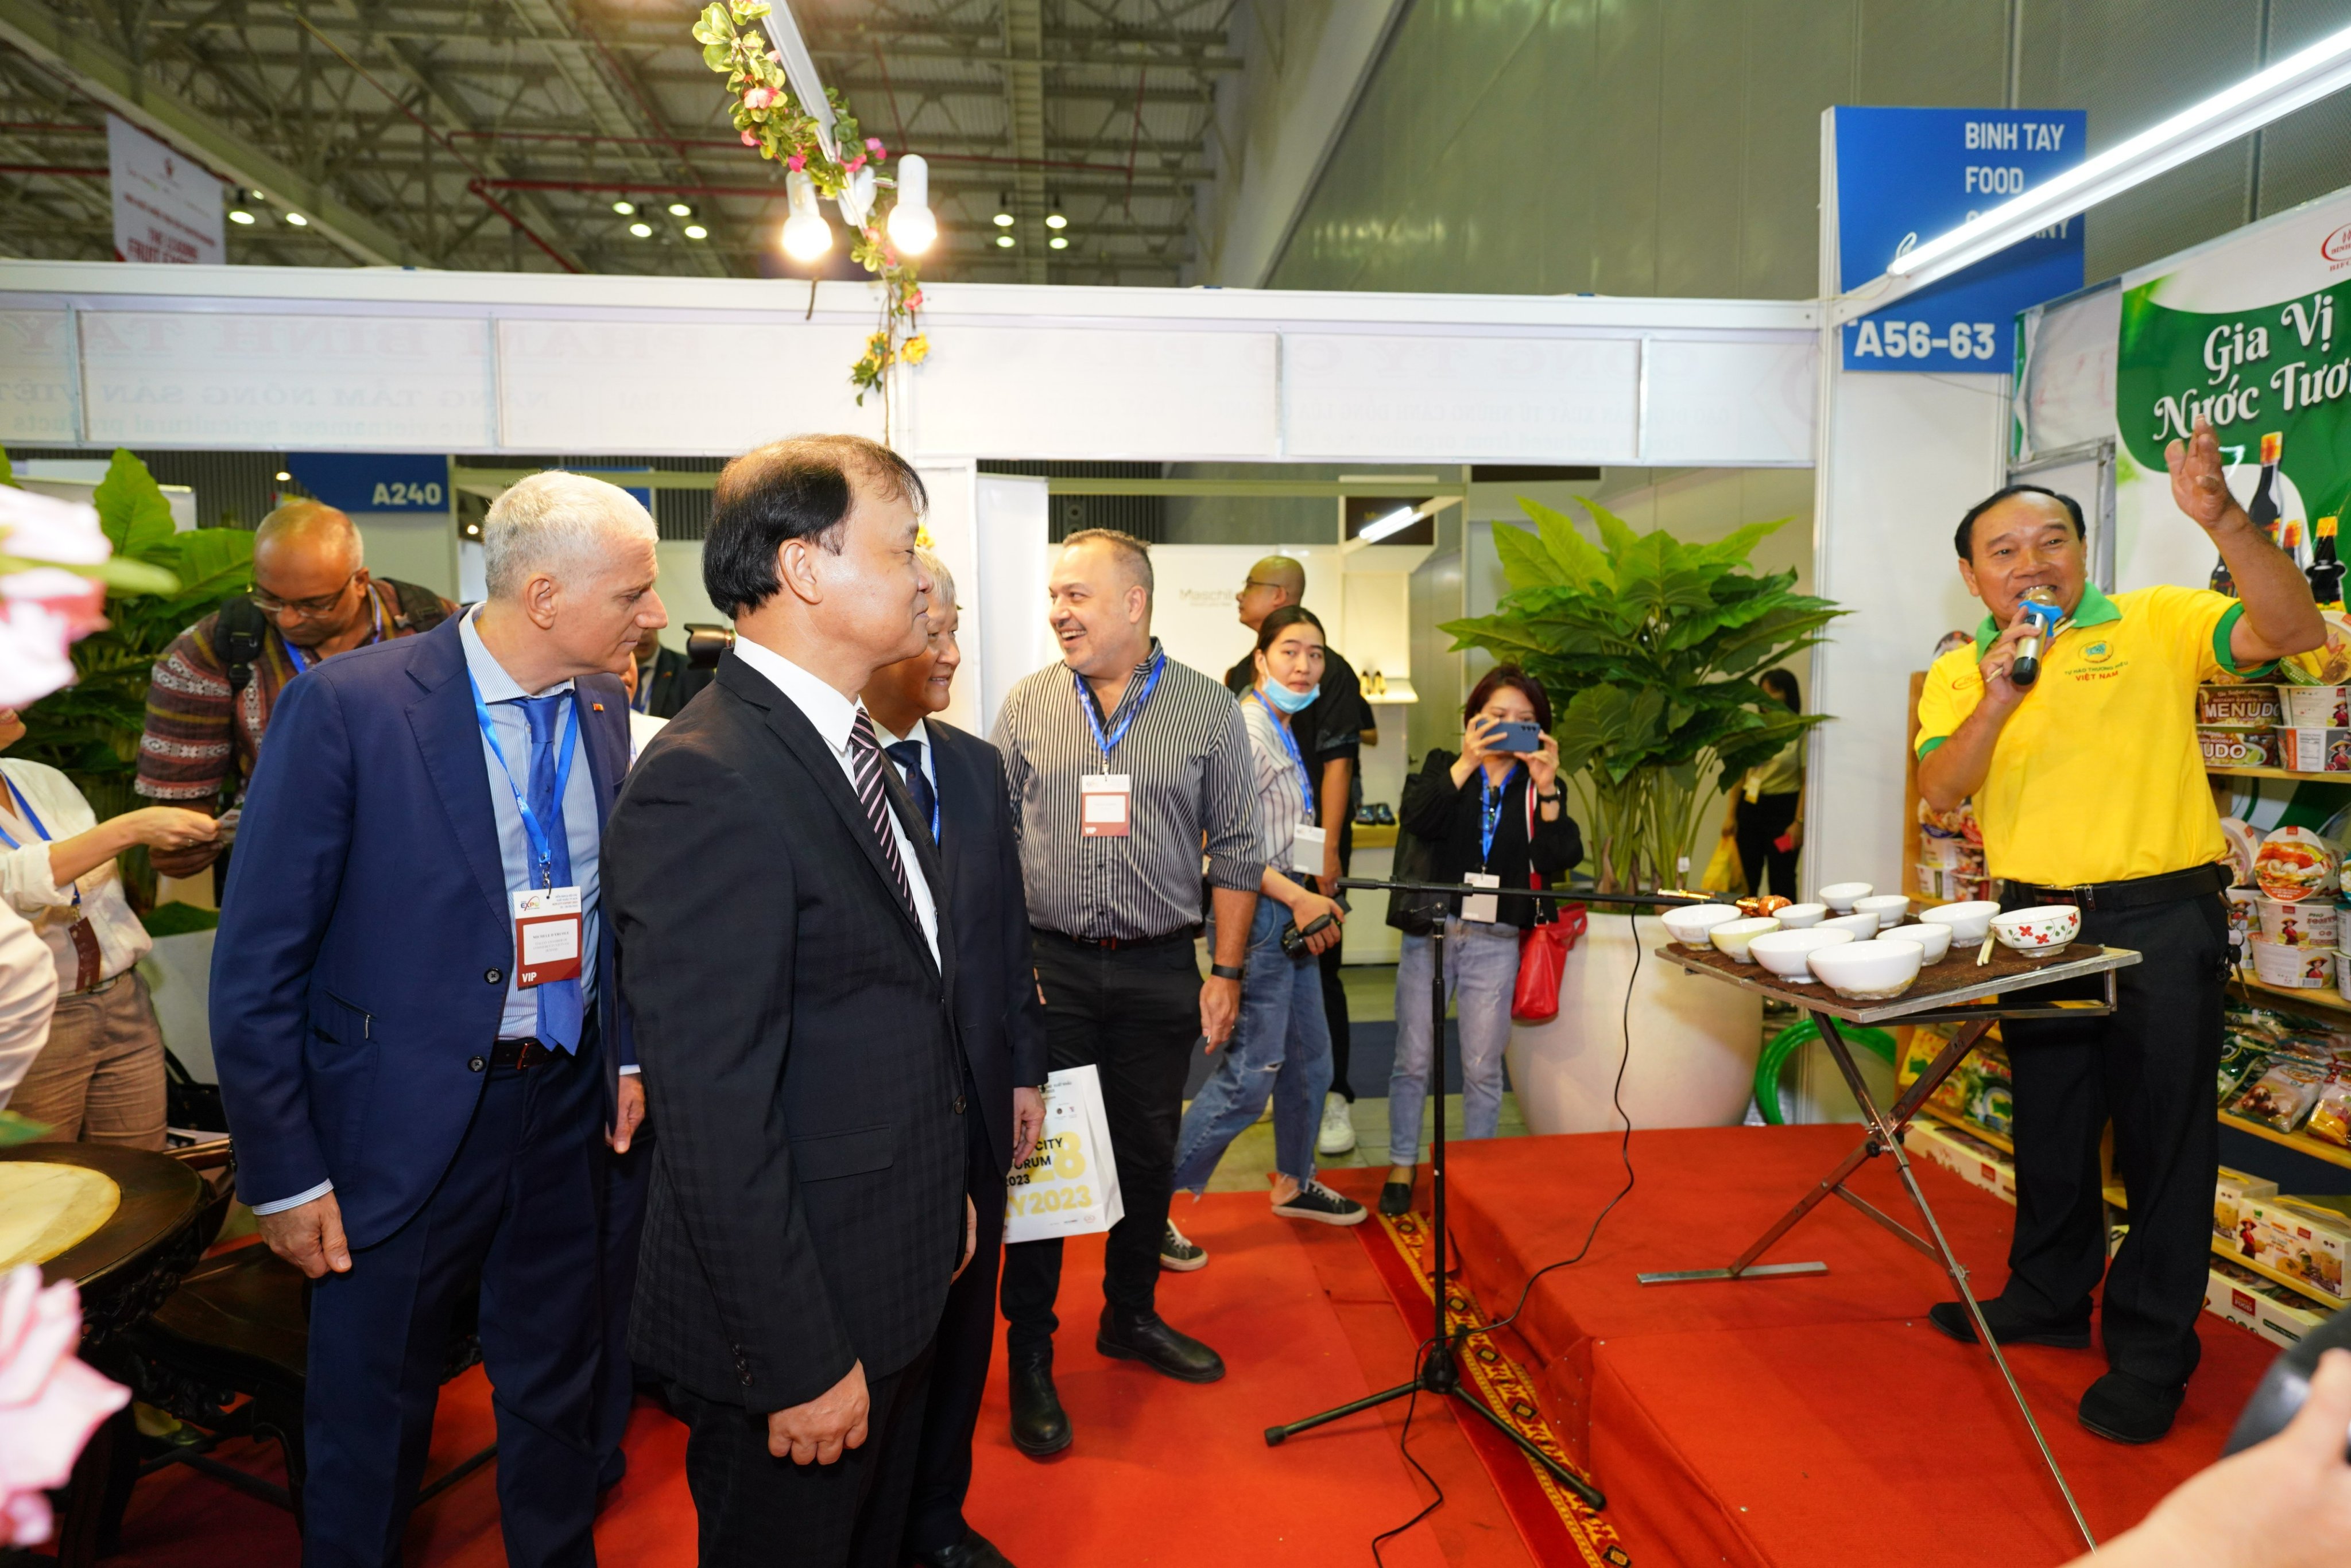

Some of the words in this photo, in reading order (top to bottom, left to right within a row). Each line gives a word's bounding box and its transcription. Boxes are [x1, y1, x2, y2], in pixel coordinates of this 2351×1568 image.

[1965, 122, 2019, 150] BINH
[2022, 123, 2065, 151] TAY
[1965, 167, 2024, 194] FOOD
[1854, 322, 1996, 359] A56-63
[2203, 322, 2270, 386] Gia
[2280, 293, 2334, 352] Vị
[2152, 374, 2261, 441] Nước
[2270, 357, 2351, 412] Tươ
[372, 482, 442, 506] A240
[2075, 673, 2096, 682] VIỆT
[2099, 670, 2118, 680] NAM
[2201, 743, 2247, 759] UDO
[522, 972, 537, 983] VIP
[1035, 1137, 1063, 1151] CITY
[1012, 1155, 1052, 1170] ORUM
